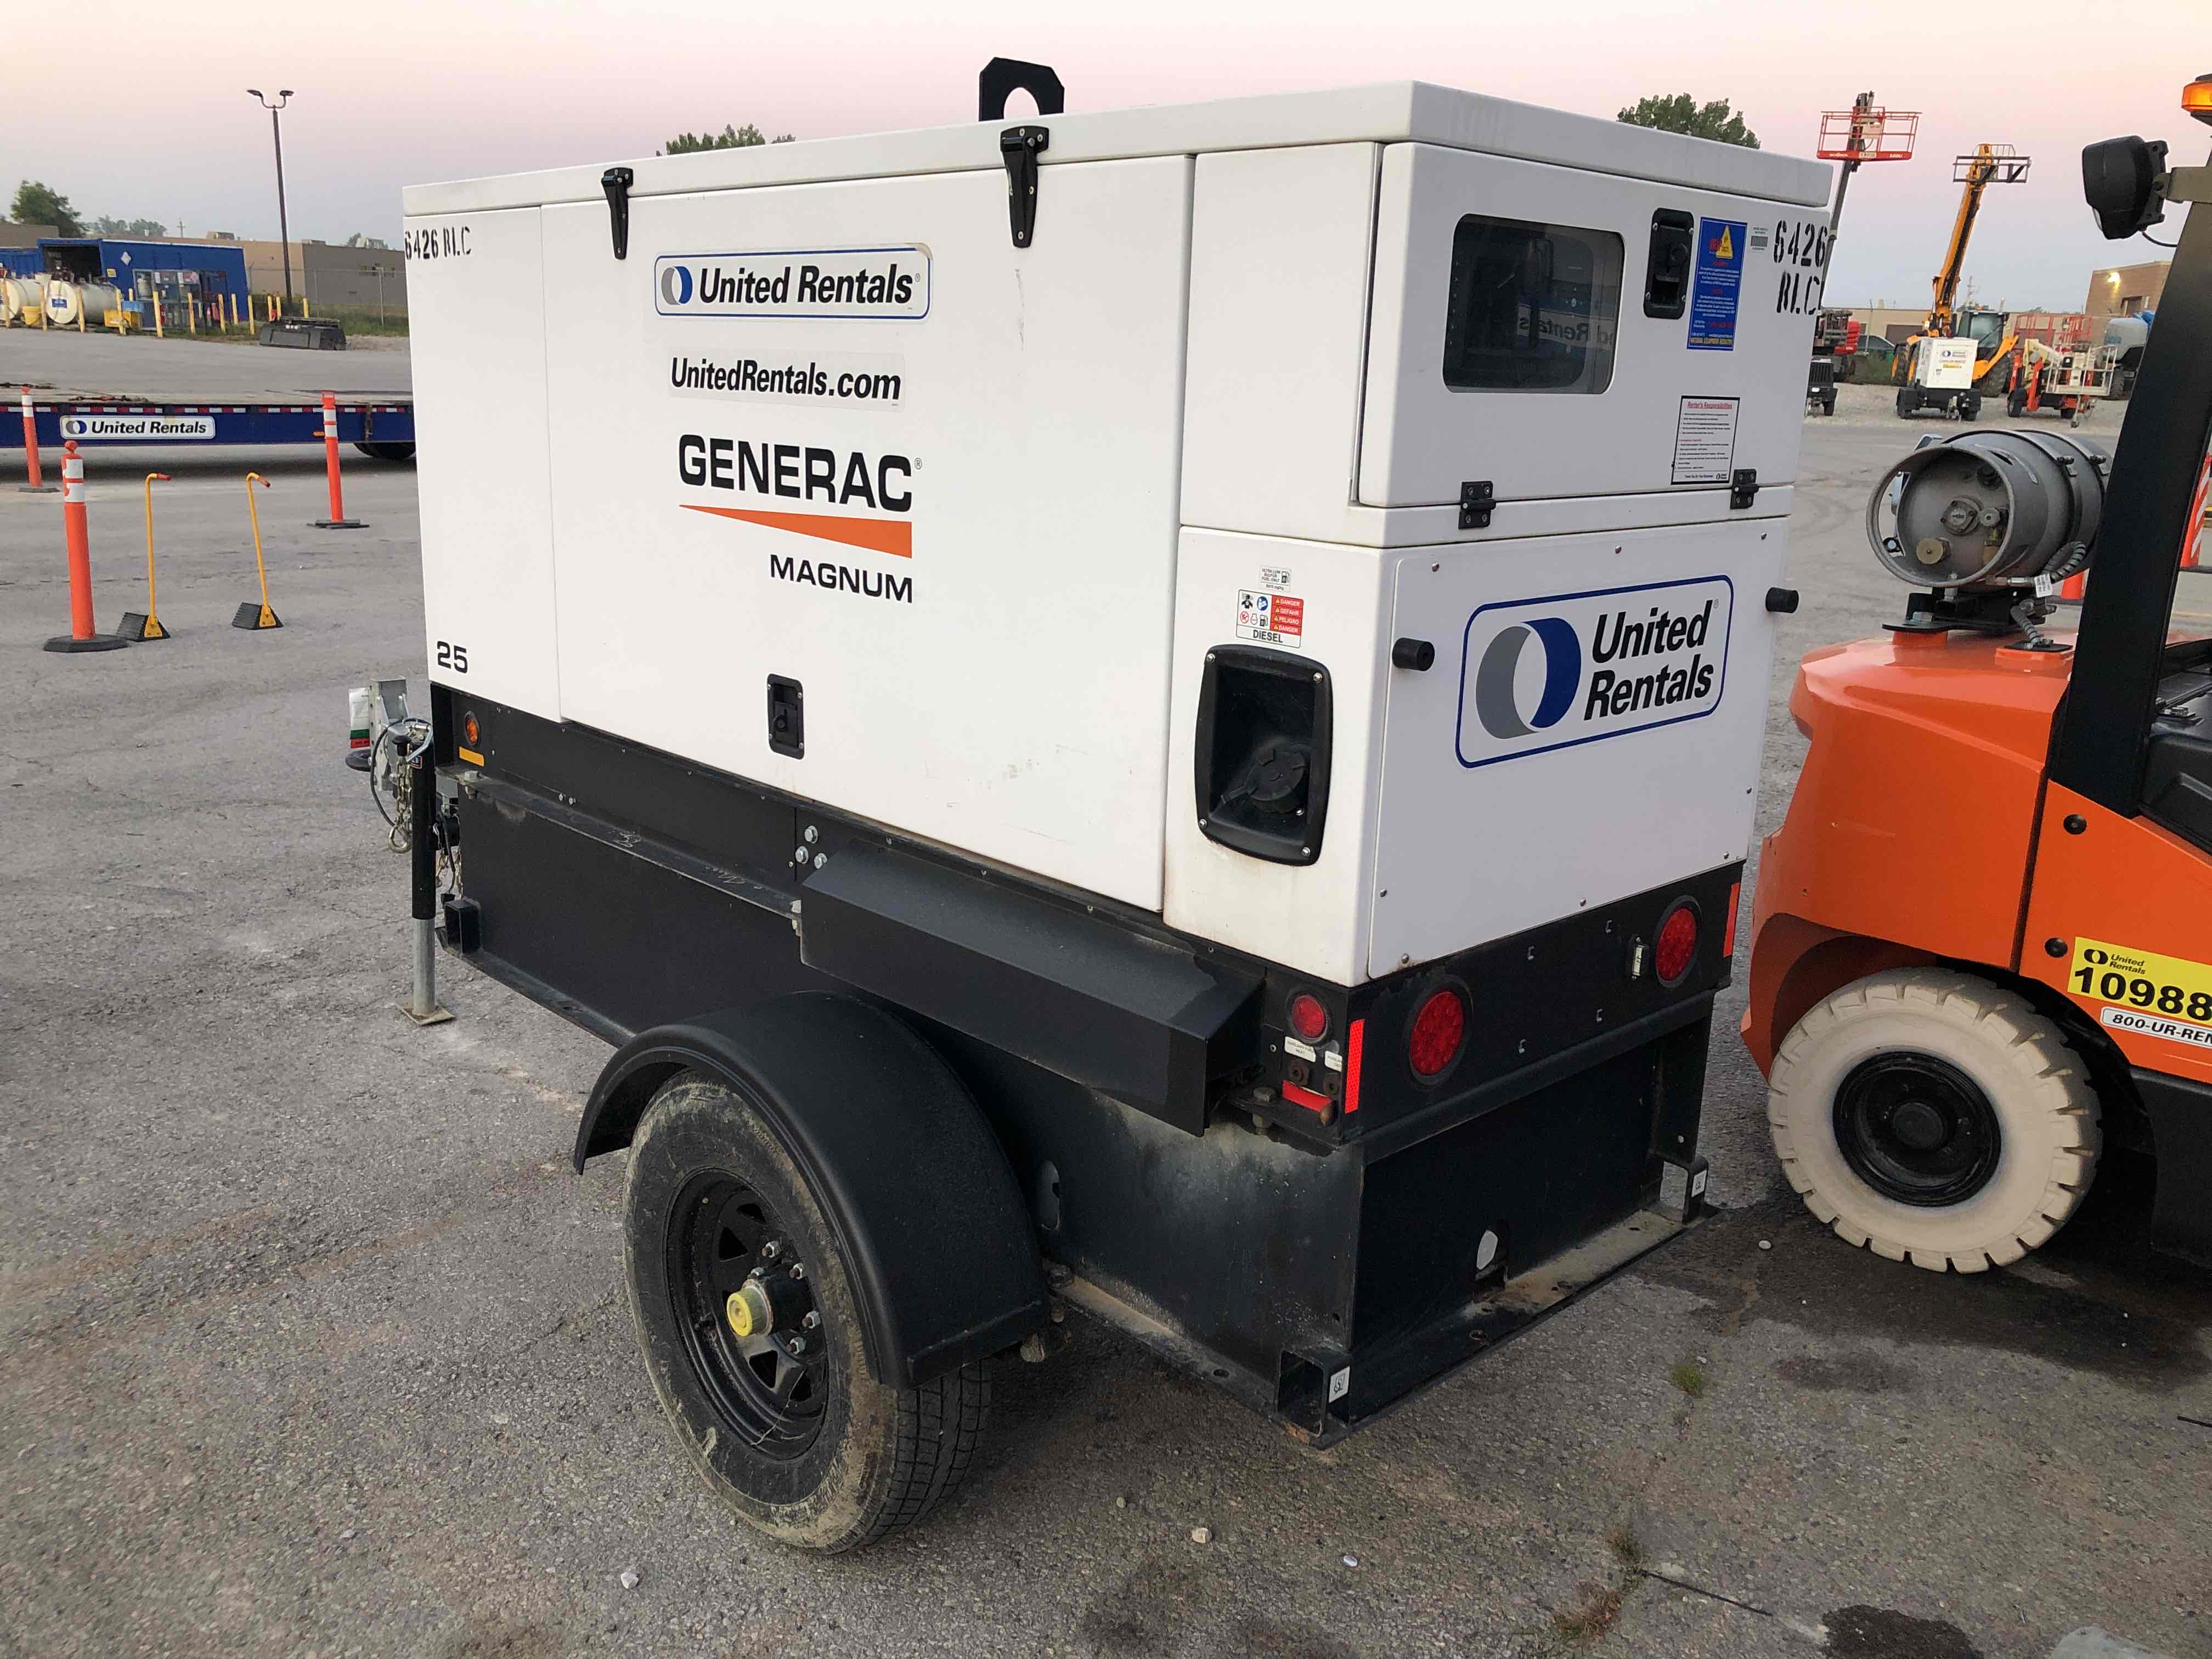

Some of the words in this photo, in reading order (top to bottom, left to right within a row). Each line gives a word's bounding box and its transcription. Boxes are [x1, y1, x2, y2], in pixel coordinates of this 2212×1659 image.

[405, 229, 439, 260] 6426
[1774, 220, 1828, 267] 6426
[699, 266, 791, 303] United
[797, 263, 912, 303] Rentals
[672, 357, 901, 400] UnitedRentals.com
[92, 421, 145, 434] United
[150, 421, 207, 434] Rentals
[679, 434, 912, 512] GENERAC
[770, 554, 912, 603] MAGNUM
[1252, 629, 1283, 643] DIESEL
[1592, 600, 1713, 663] United
[437, 641, 468, 674] 25
[1583, 654, 1714, 721] Rentals
[2109, 961, 2146, 975] Rentals
[2111, 953, 2145, 967] United
